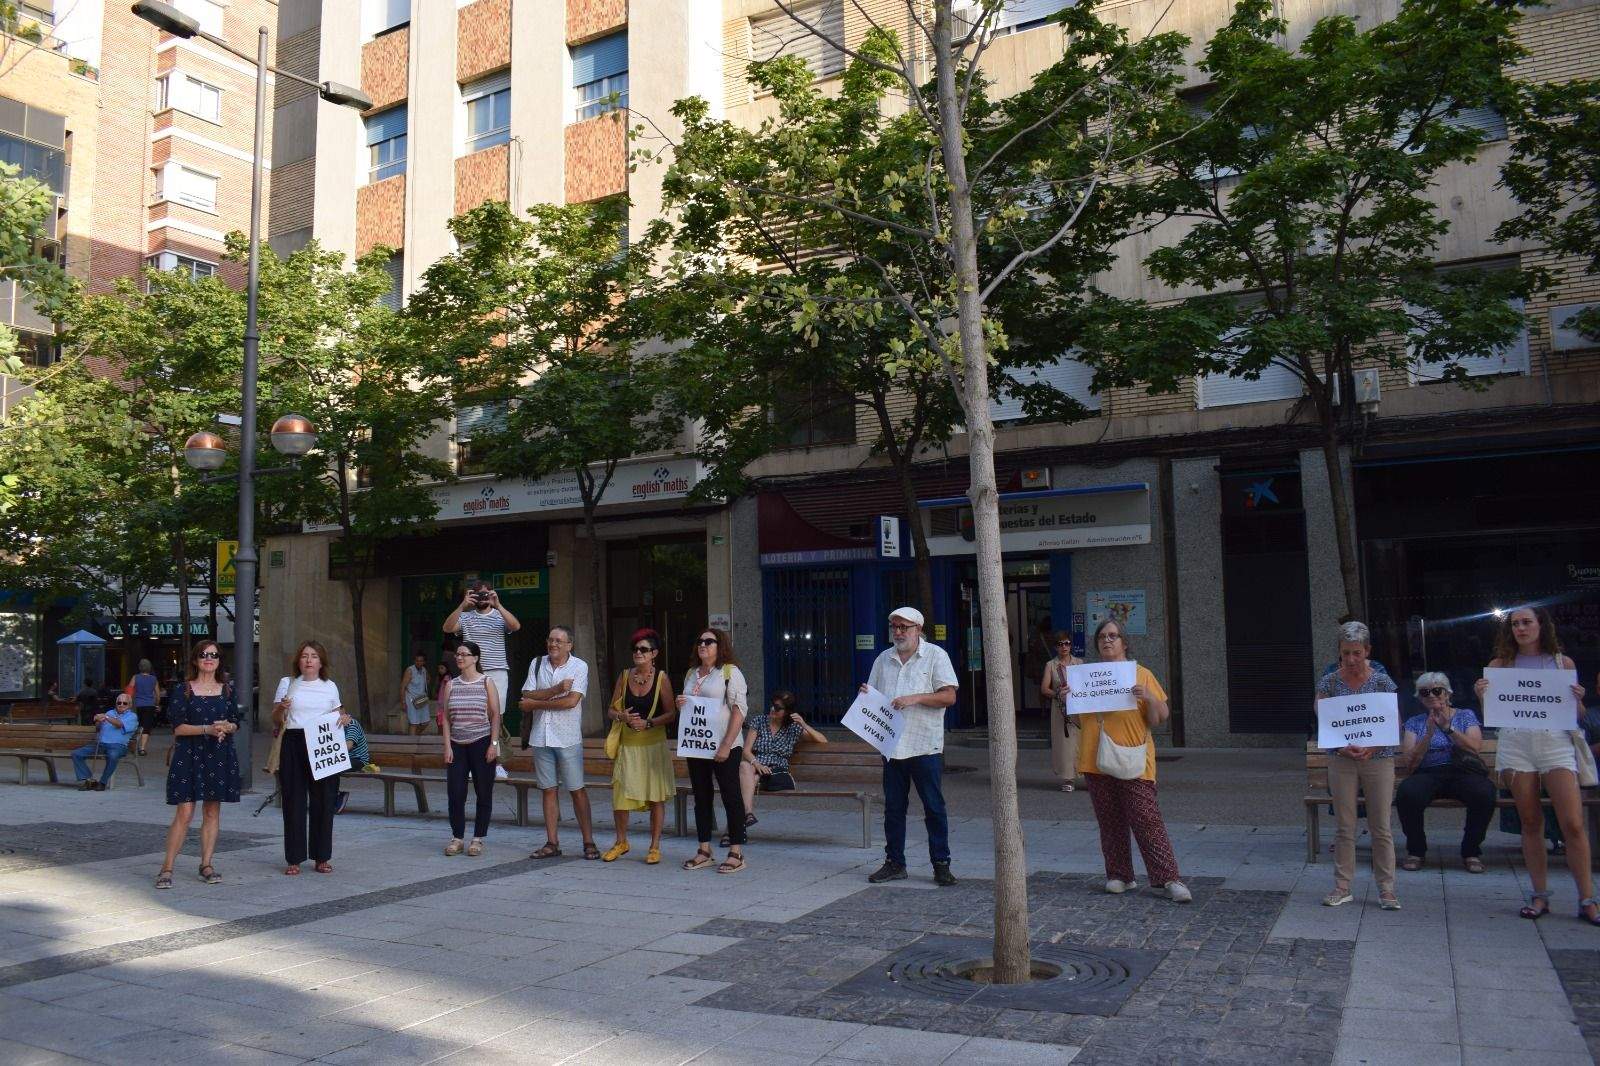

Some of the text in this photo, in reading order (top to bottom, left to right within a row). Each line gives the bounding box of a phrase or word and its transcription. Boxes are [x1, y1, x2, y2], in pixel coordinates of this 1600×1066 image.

[632, 480, 660, 500] english
[662, 479, 688, 492] maths
[463, 500, 487, 515] english
[489, 497, 510, 508] maths
[1031, 503, 1038, 516] y
[1038, 514, 1055, 526] del
[1059, 511, 1097, 525] Estado
[809, 550, 816, 561] Y
[824, 548, 873, 561] PRIMITIVA
[506, 575, 536, 586] ONCE
[108, 623, 139, 635] CAE
[151, 623, 175, 635] BAR
[1089, 670, 1112, 678] VIVAS
[1091, 679, 1117, 688] LIBRES
[1518, 680, 1542, 688] NOS
[1071, 687, 1130, 699] NOS QUEREMOS
[1498, 694, 1562, 704] QUEREMOS
[694, 705, 705, 715] NI
[879, 706, 894, 720] NOS
[1347, 703, 1367, 713] NOS
[1513, 710, 1547, 719] VIVAS
[318, 722, 330, 733] NI
[691, 716, 706, 727] UN
[861, 707, 896, 739] QUEREMOS
[1331, 715, 1385, 728] QUEREMOS
[684, 727, 713, 738] PASO
[864, 723, 885, 742] VIVAS
[1344, 730, 1373, 741] VIVAS
[318, 733, 333, 745] UN
[681, 739, 717, 751] ATRÁS
[314, 743, 341, 758] PASO
[315, 753, 347, 771] ATRÁS
